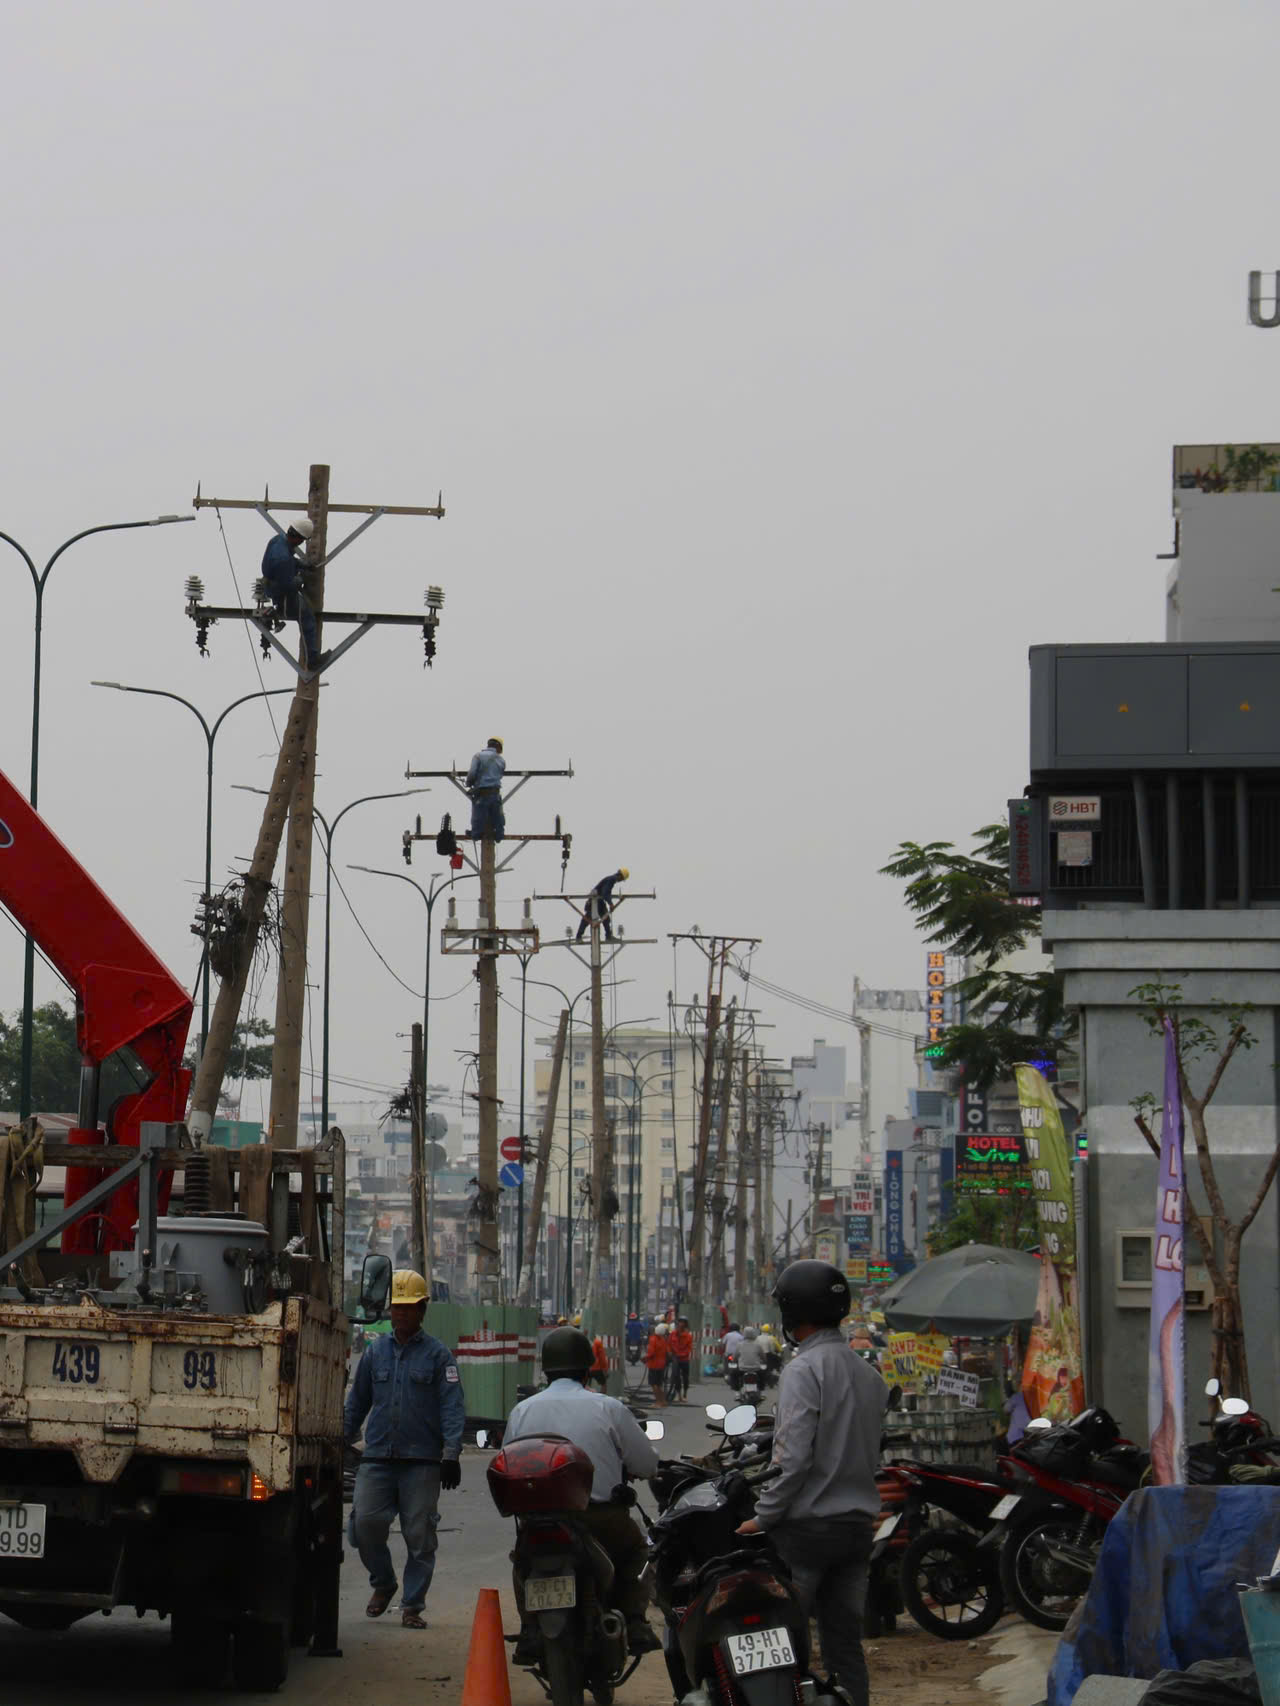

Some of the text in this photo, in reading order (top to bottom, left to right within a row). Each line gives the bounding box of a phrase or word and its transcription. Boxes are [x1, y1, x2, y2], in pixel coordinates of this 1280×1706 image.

[1070, 802, 1097, 813] HBT
[928, 951, 945, 1043] HOTEL
[967, 1136, 1021, 1150] HOTEL
[889, 1171, 899, 1210] LONG
[52, 1343, 100, 1385] 439
[183, 1349, 217, 1390] 99
[737, 1630, 781, 1652] 49-H1
[734, 1646, 793, 1673] 377.68
